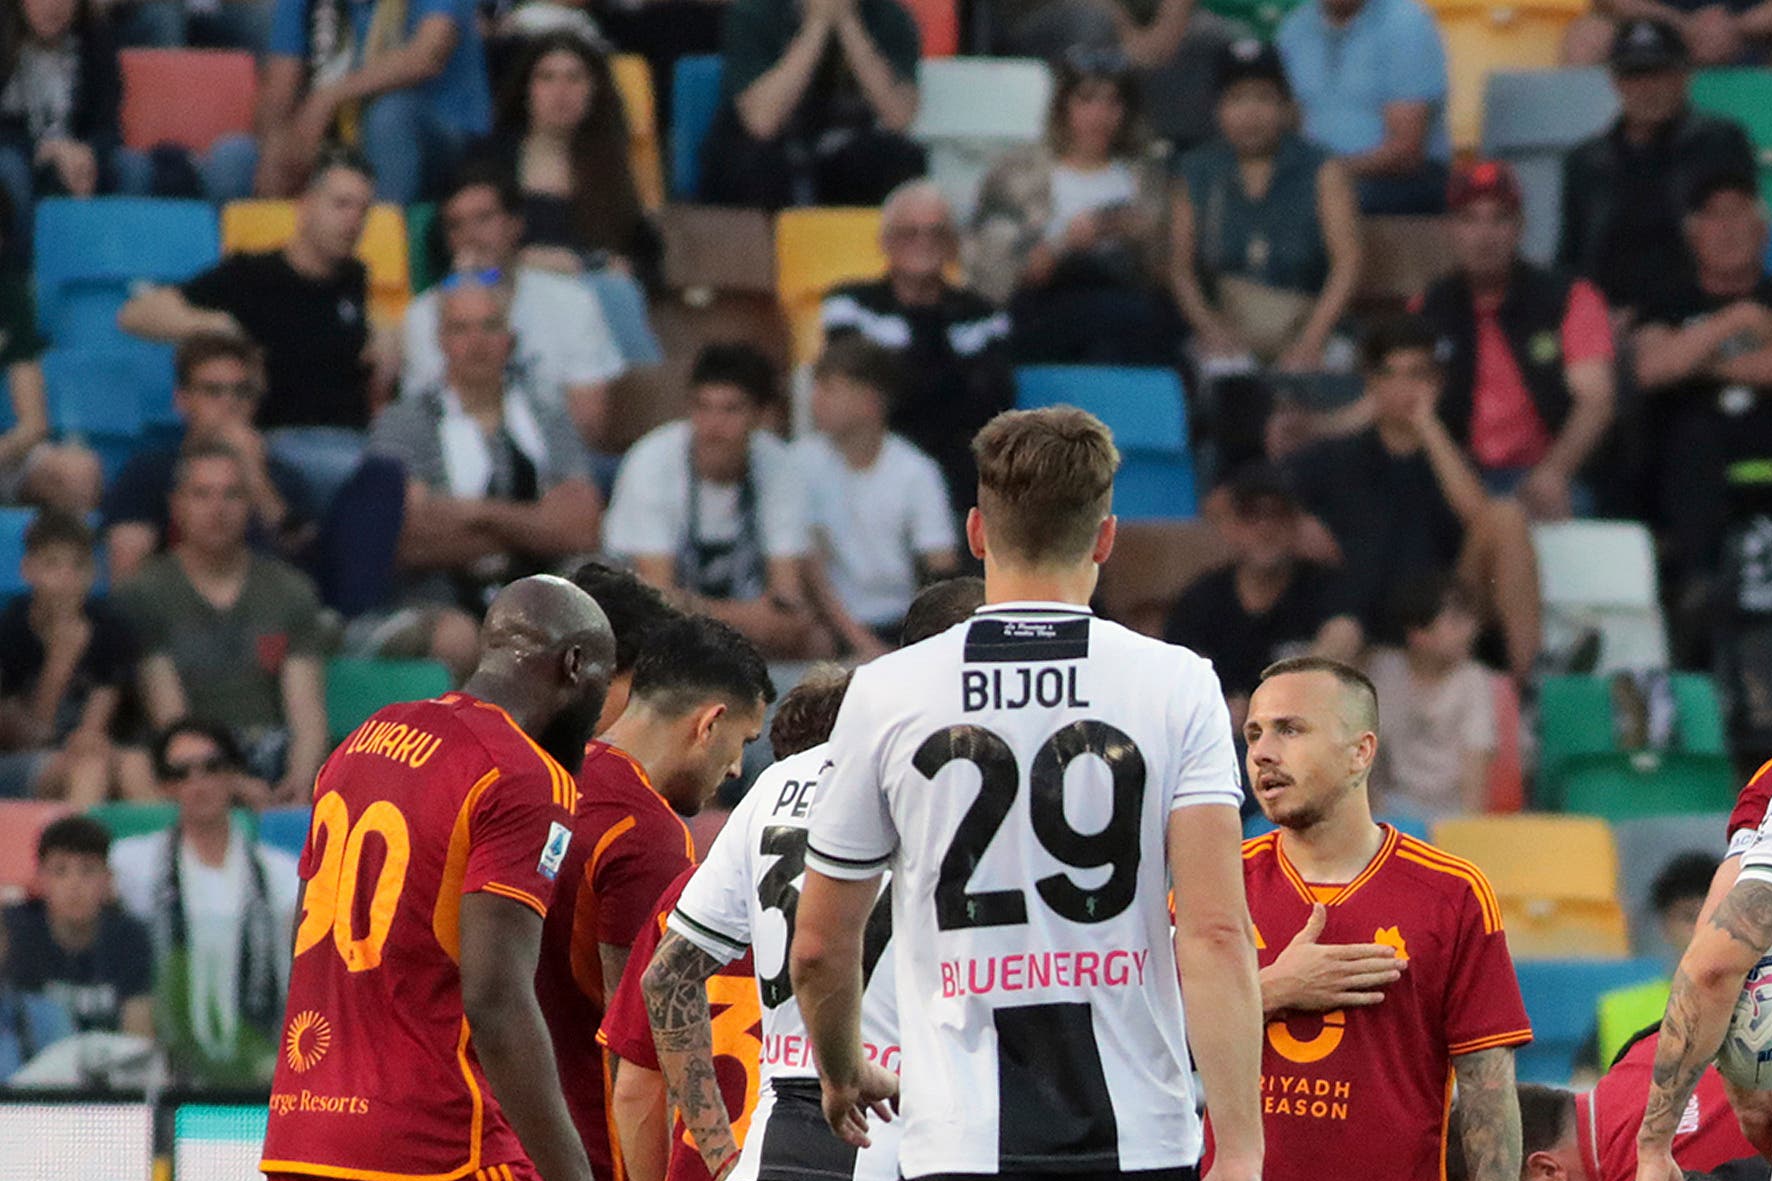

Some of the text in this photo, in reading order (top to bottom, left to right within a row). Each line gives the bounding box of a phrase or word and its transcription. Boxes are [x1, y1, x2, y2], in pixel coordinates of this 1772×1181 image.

[962, 666, 1089, 712] BIJOL
[772, 779, 817, 818] PE
[911, 719, 1147, 932] 29
[294, 789, 411, 973] 90
[940, 949, 1148, 999] BLUENERGY
[300, 1088, 370, 1114] Resorts
[1263, 1096, 1348, 1120] EASON
